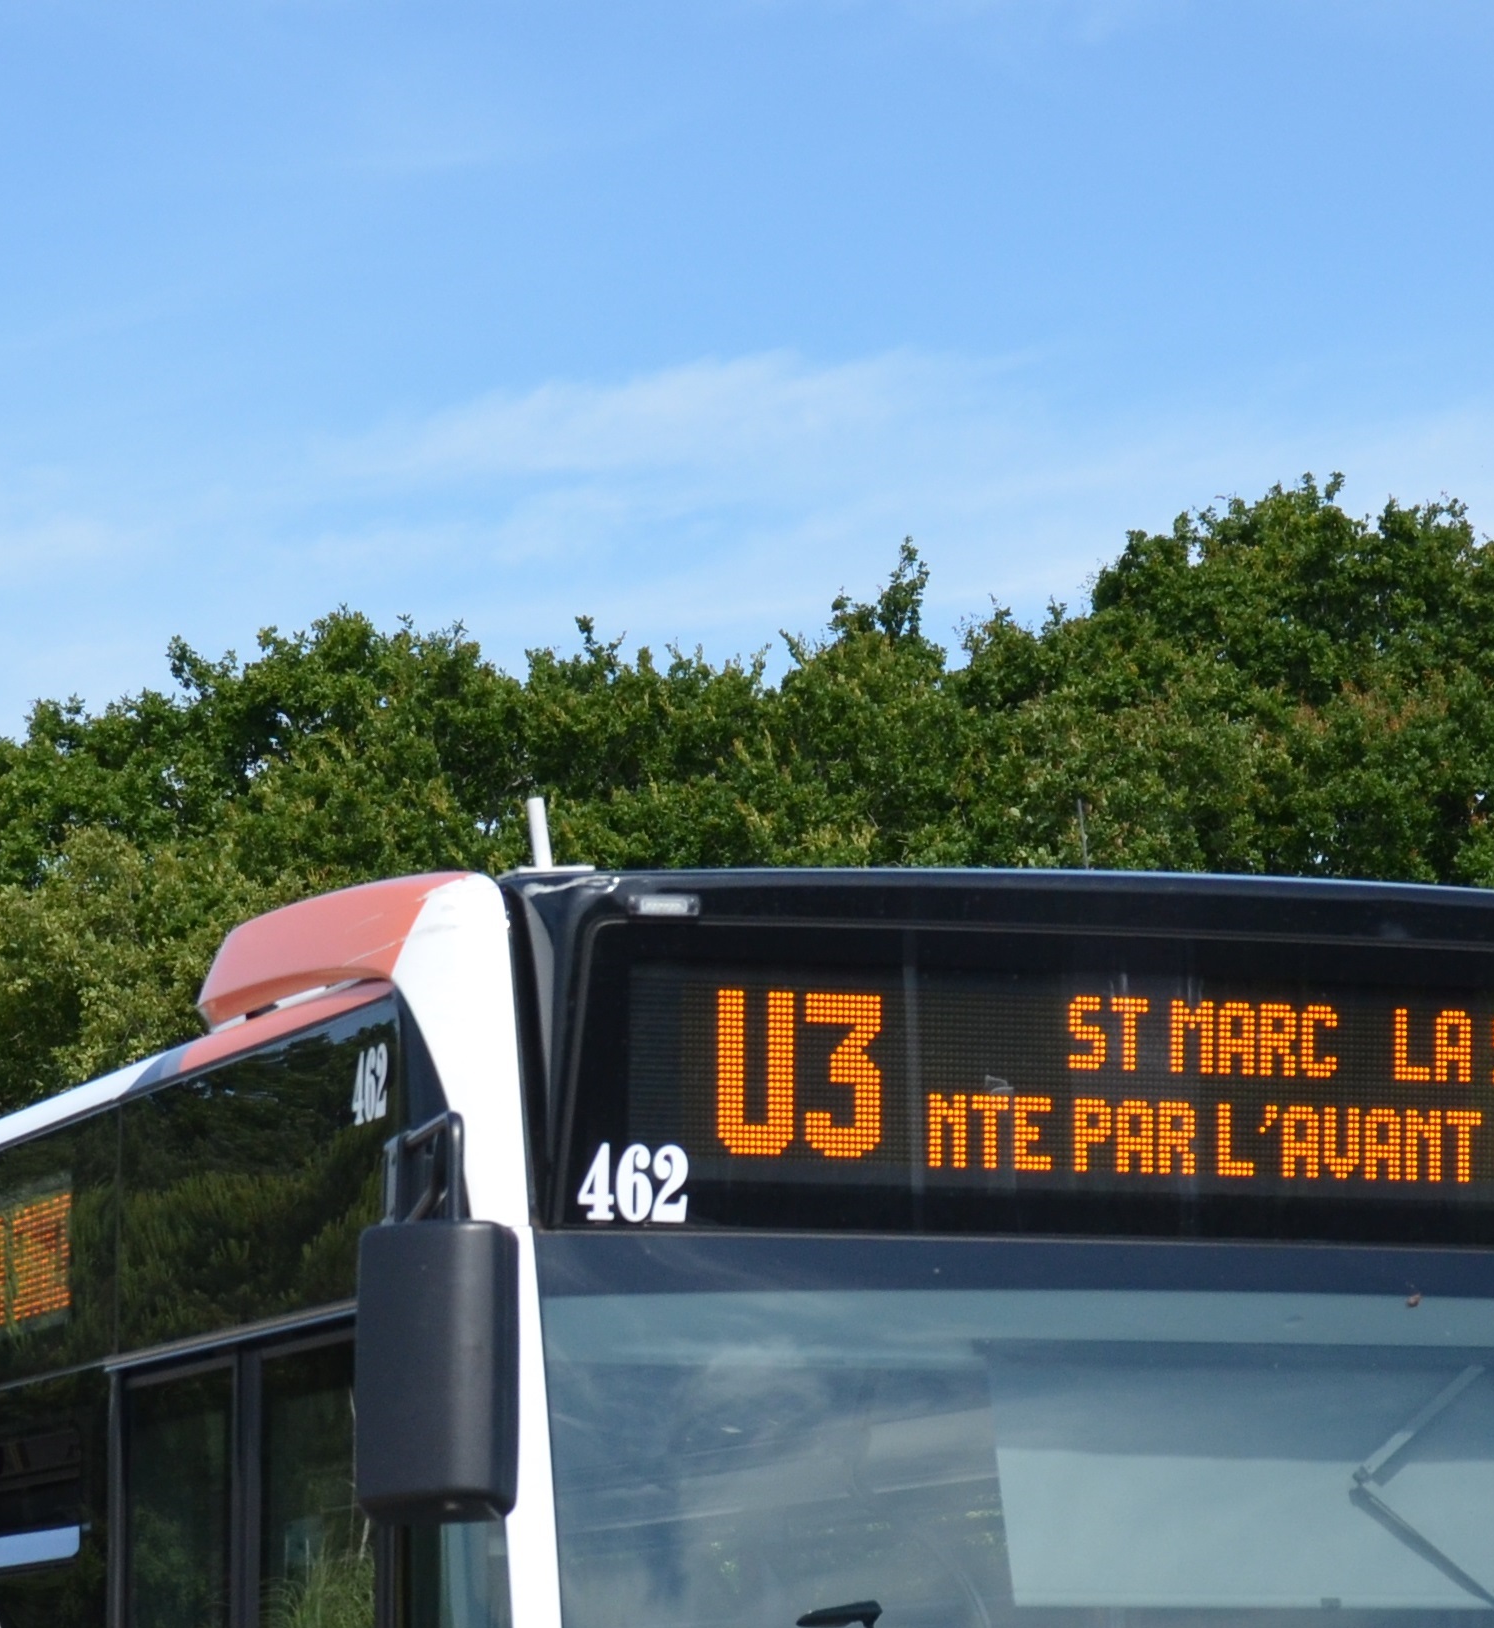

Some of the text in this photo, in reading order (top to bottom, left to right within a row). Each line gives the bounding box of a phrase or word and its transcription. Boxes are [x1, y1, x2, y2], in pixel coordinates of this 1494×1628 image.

[717, 989, 881, 1157] U3
[1068, 995, 1149, 1071] ST
[1170, 999, 1338, 1077] MARC
[1394, 1007, 1471, 1083] LA
[351, 1042, 388, 1126] 462
[927, 1093, 1052, 1171] NTE
[1074, 1097, 1196, 1175] PAR
[1216, 1103, 1482, 1182] L'AVANT
[577, 1142, 689, 1224] 462
